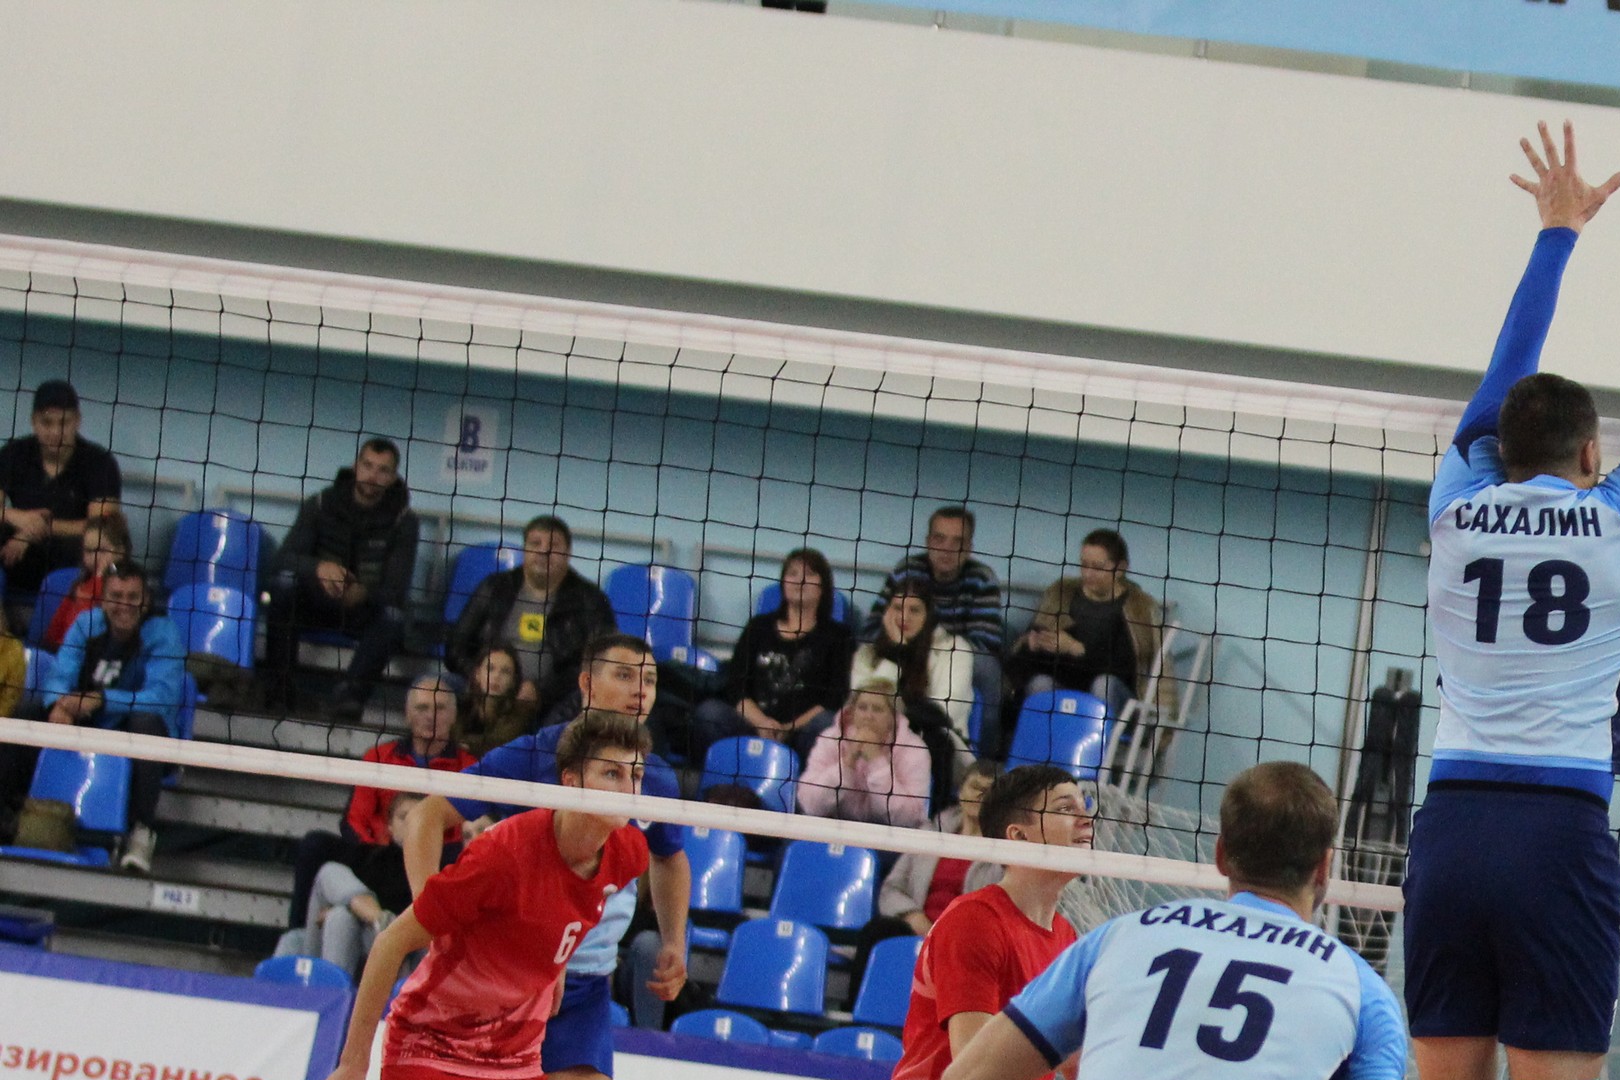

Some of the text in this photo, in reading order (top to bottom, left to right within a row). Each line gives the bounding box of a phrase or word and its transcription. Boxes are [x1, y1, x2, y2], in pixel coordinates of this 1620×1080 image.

[1455, 501, 1602, 537] САХАЛИН
[1463, 557, 1592, 645] 18
[553, 921, 582, 965] 6
[1139, 905, 1338, 963] САХАЛИН
[1139, 948, 1294, 1063] 15
